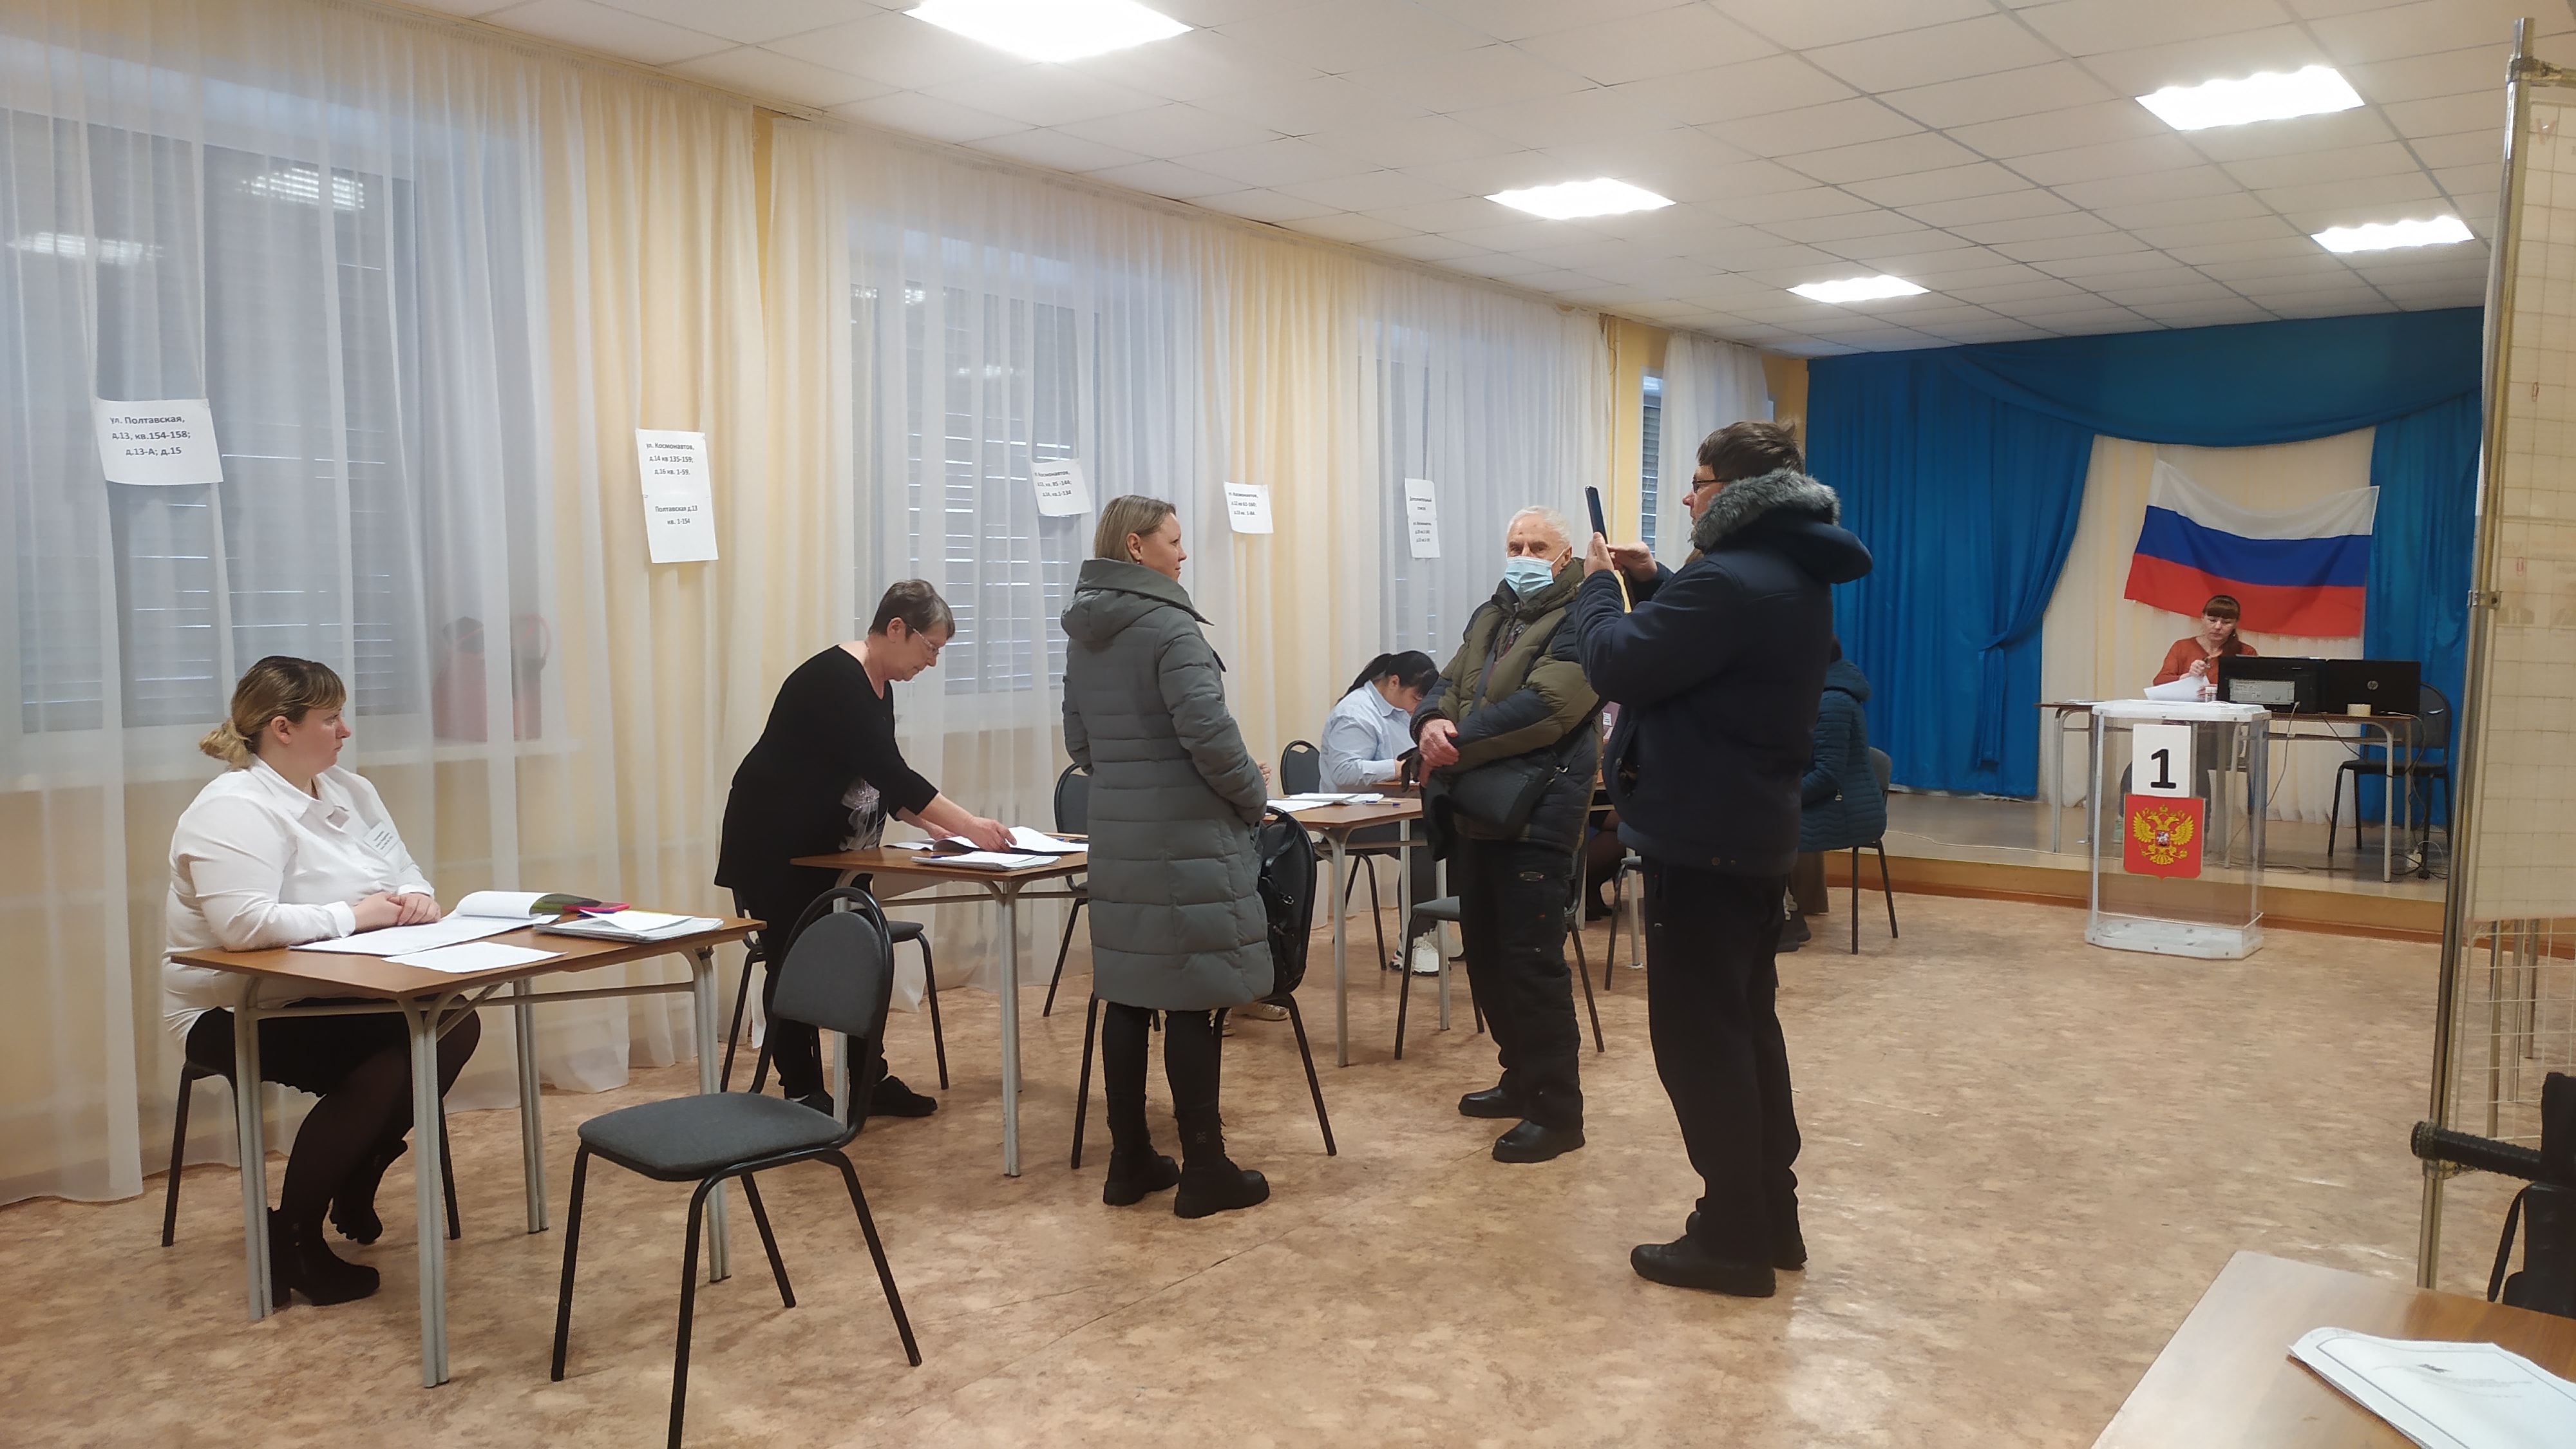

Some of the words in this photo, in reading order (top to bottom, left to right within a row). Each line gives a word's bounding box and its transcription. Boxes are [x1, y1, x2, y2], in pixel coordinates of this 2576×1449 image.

[124, 416, 185, 424] Полтавская,
[112, 432, 133, 440] д.13,
[135, 431, 191, 440] кв.154-158;
[160, 447, 182, 456] д.15
[2150, 748, 2177, 789] 1
